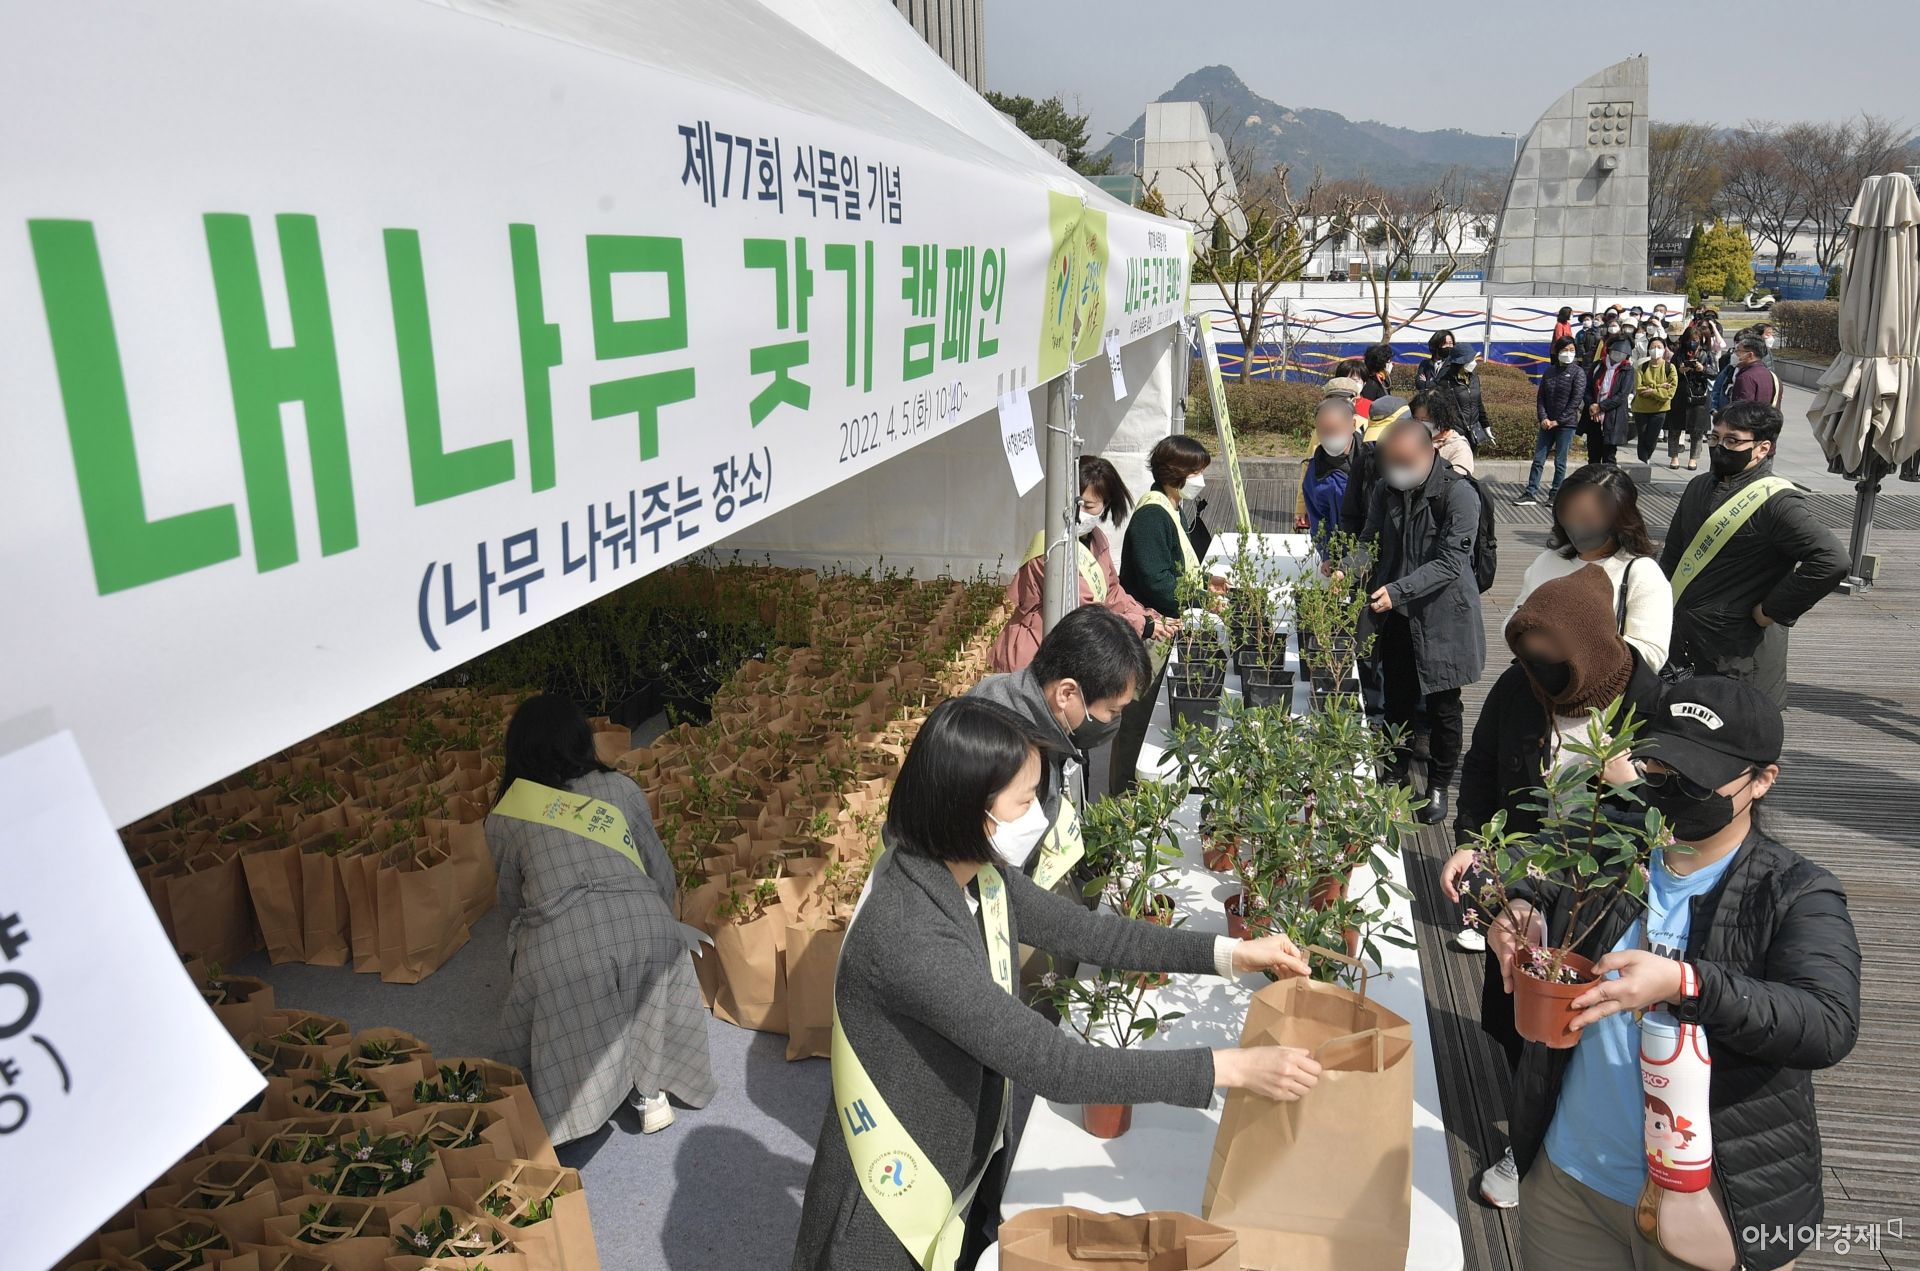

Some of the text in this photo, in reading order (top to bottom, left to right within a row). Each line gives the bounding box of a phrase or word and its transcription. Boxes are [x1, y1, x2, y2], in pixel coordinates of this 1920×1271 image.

[678, 120, 902, 224] 제77회 식목일 기념
[743, 236, 874, 429] 갖기
[902, 243, 1006, 382] 캠페인
[839, 411, 881, 463] 2022.
[886, 404, 898, 442] 4.
[418, 446, 772, 652] (나무 나눠주는 장소)
[587, 806, 608, 833] 식목일
[599, 815, 615, 833] 기념
[843, 1098, 878, 1137] 내
